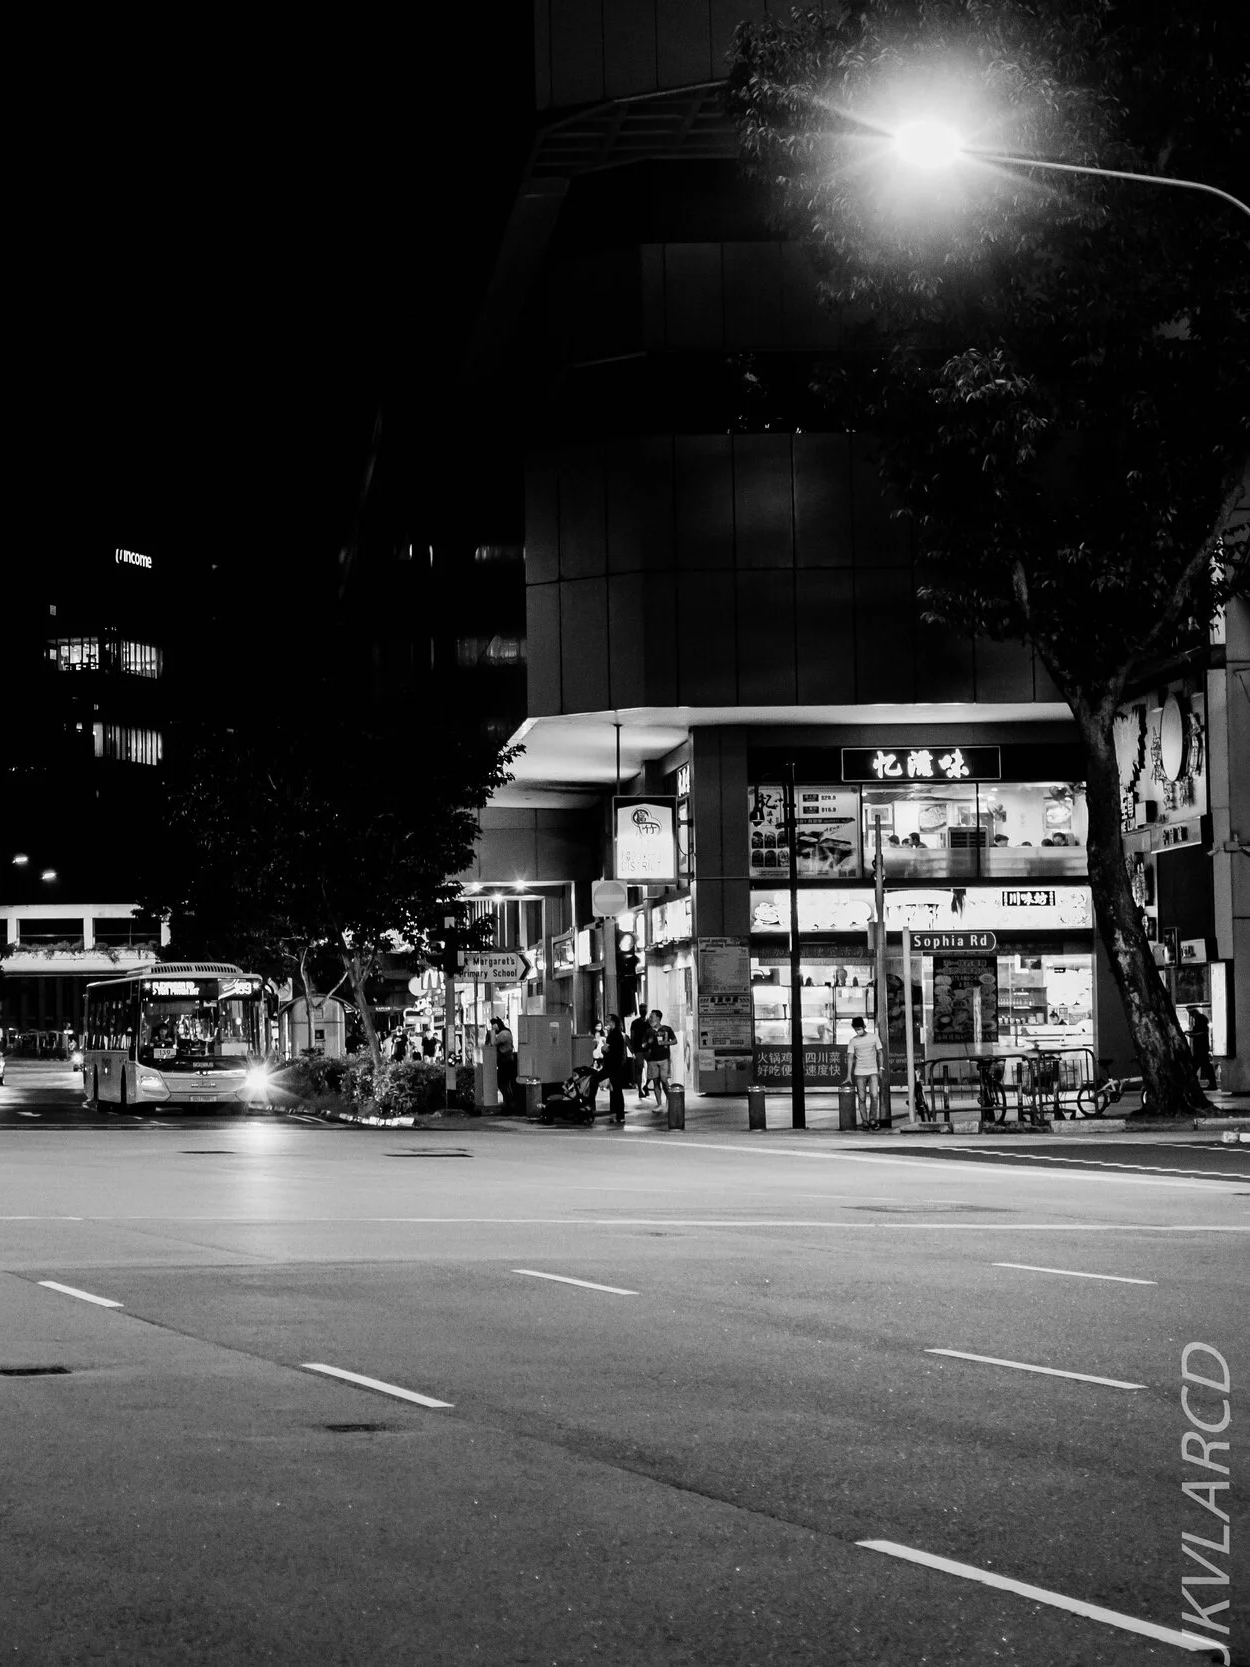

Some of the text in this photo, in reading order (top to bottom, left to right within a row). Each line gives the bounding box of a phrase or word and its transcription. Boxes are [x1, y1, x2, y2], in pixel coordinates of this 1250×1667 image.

[872, 748, 970, 778] 忆滋味
[913, 934, 988, 950] Sophia Rd
[472, 956, 515, 968] Margaret's
[492, 968, 518, 978] School
